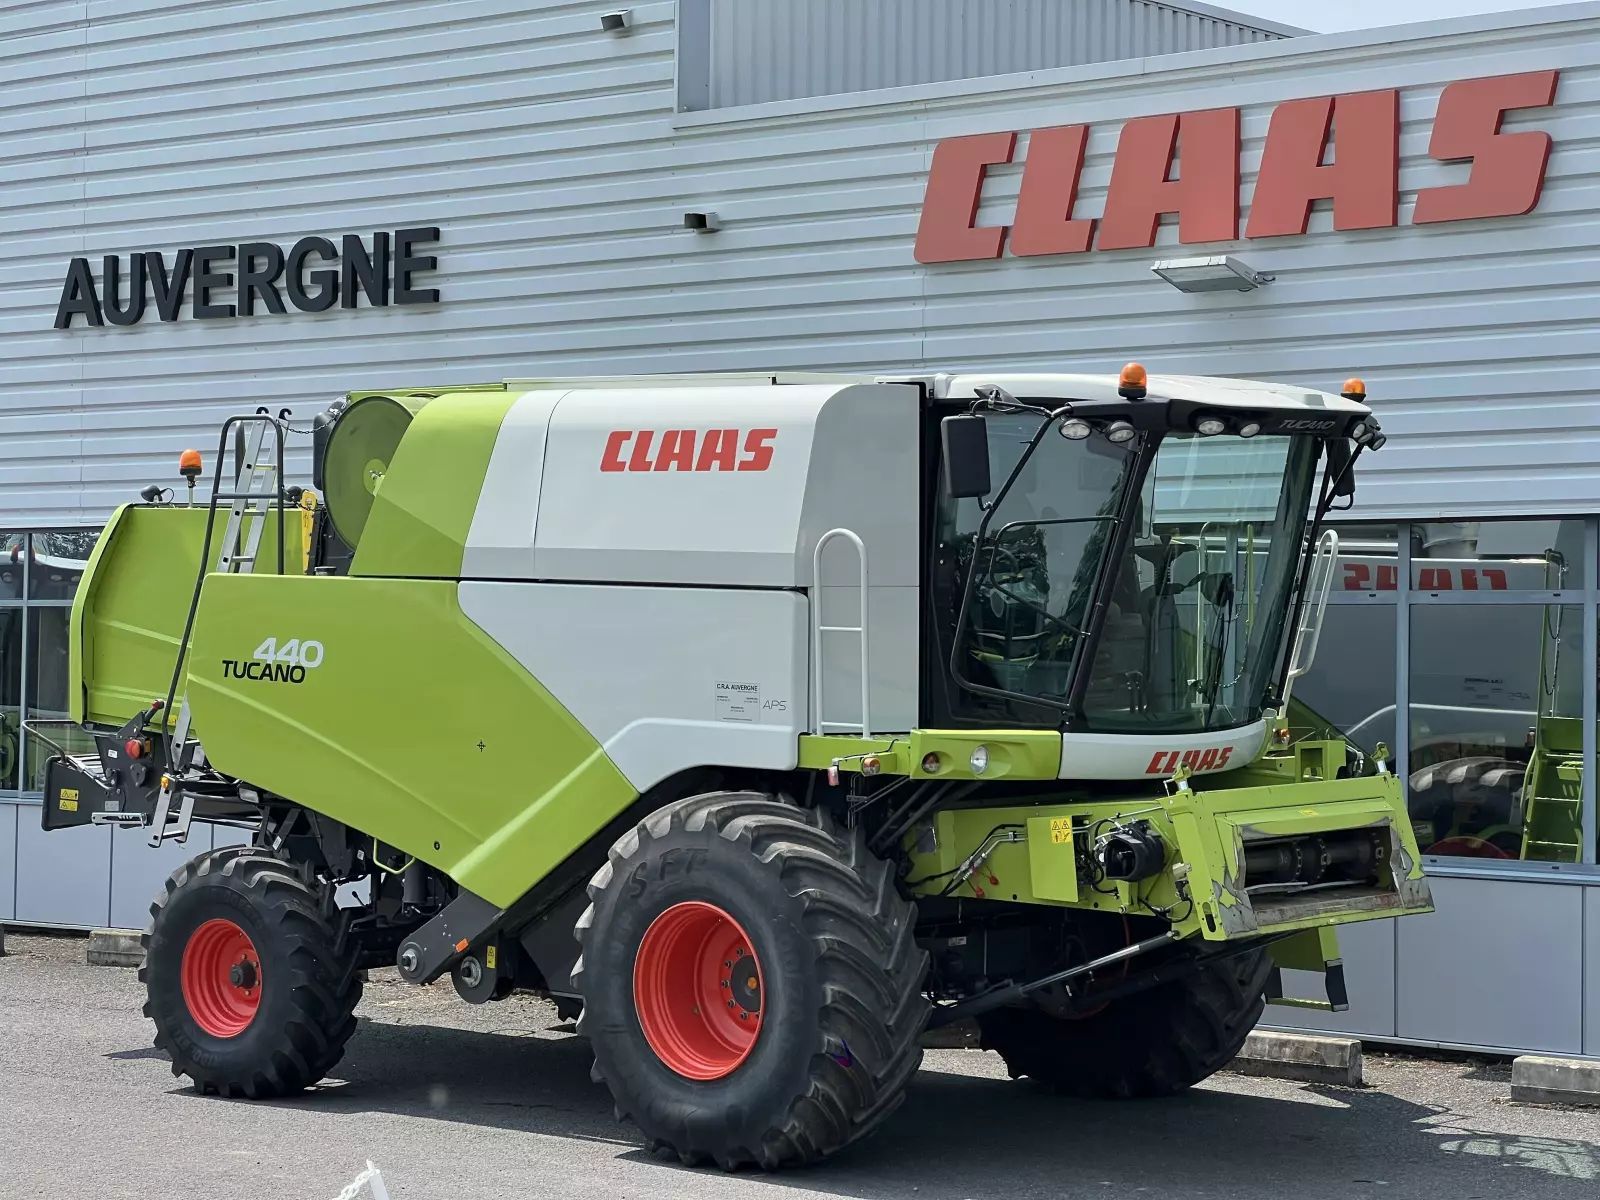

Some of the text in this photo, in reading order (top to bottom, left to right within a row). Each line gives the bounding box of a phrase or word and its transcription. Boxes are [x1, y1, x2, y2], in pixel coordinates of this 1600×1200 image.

[913, 70, 1560, 264] CLAAS
[54, 226, 440, 329] AUVERGNE
[1280, 419, 1336, 431] TUCANO
[600, 428, 778, 472] CLAAS
[253, 637, 324, 668] 440
[222, 659, 306, 684] TUCANO
[731, 684, 758, 692] AUVERGNE
[762, 700, 788, 711] APS
[1145, 746, 1234, 774] CLAAS
